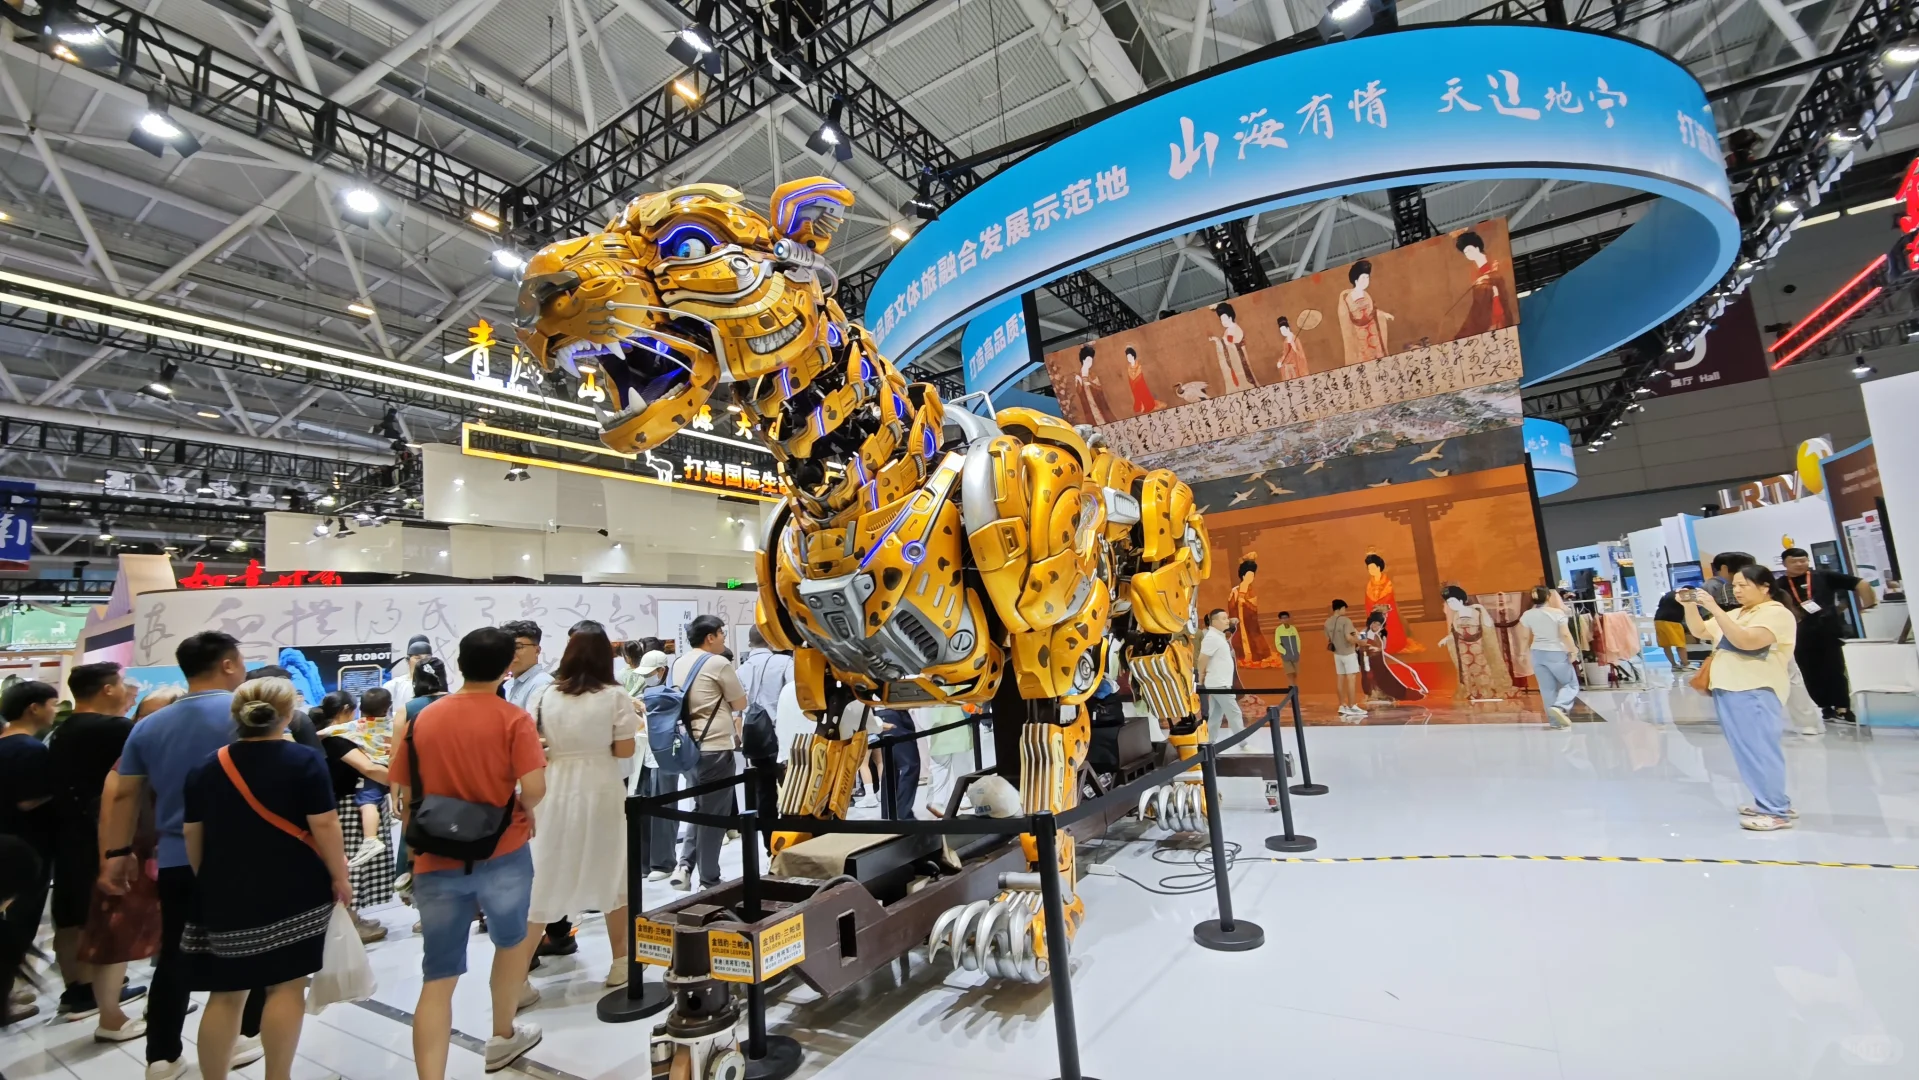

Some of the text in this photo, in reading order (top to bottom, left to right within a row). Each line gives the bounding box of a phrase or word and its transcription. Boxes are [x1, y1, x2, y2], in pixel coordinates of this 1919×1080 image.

[872, 165, 1130, 347] 品质文体旅融合发展示范地
[1168, 80, 1388, 180] 山海有情
[1670, 371, 1721, 388] 展厅 Hall
[1718, 470, 1803, 514] LRTV
[354, 651, 392, 662] ROBOT
